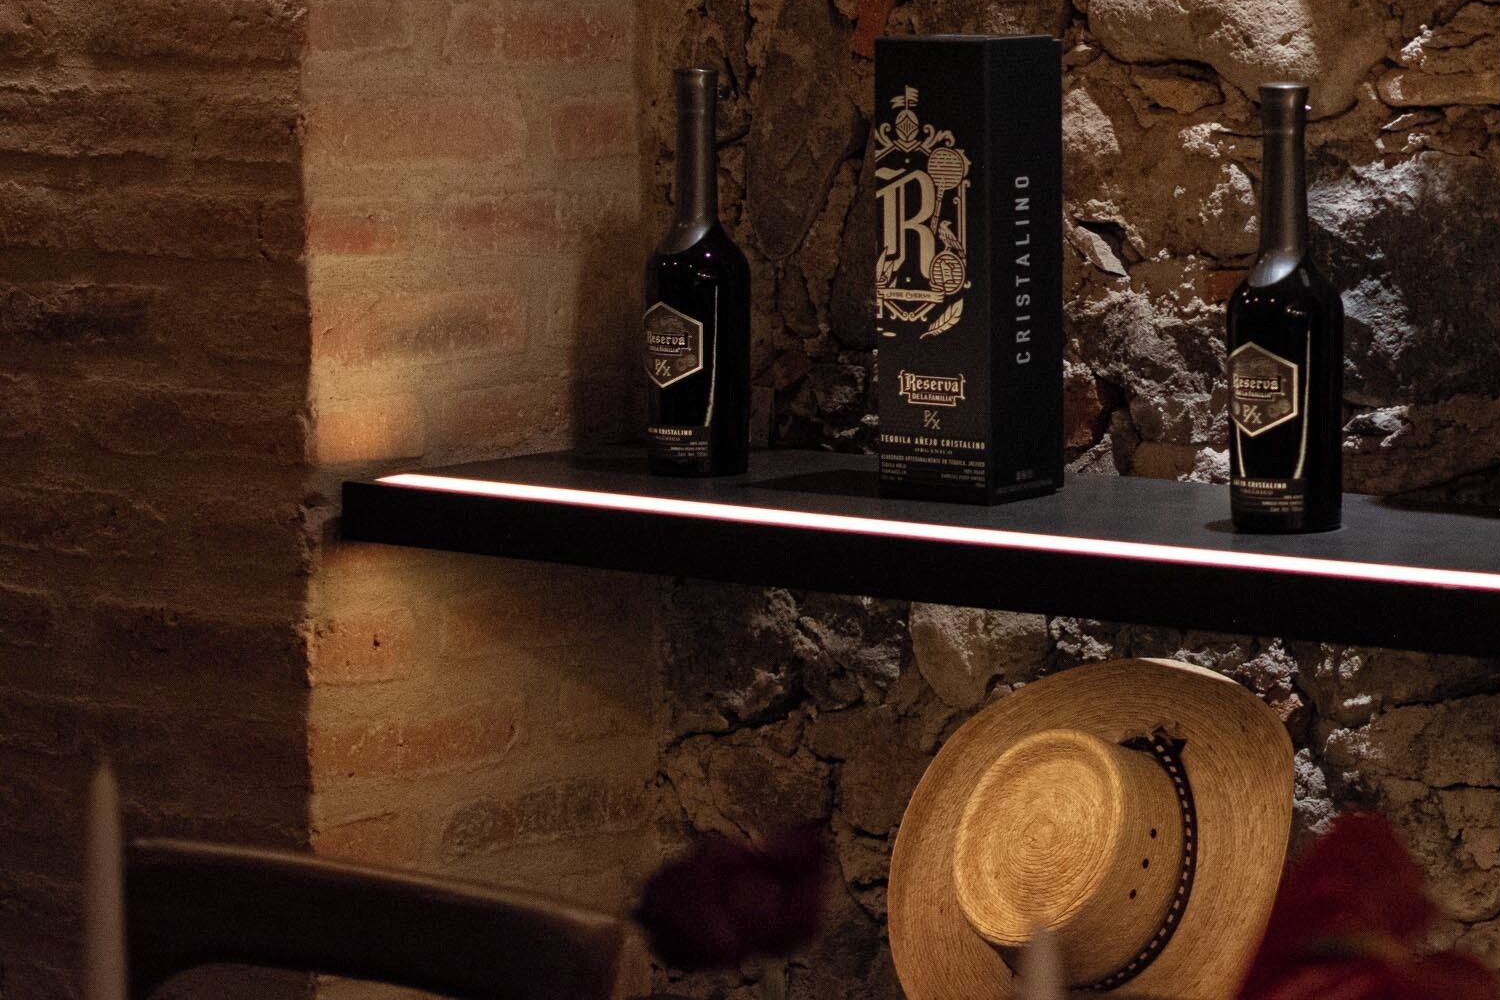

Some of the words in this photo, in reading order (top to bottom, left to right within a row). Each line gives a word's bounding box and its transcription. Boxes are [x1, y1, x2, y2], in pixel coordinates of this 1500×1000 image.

[1015, 175, 1031, 364] CRISTALINO
[903, 373, 959, 392] Reserva
[1232, 373, 1279, 390] Reserva
[881, 433, 911, 444] TEQUILA
[914, 436, 938, 447] AÑEJO
[941, 439, 985, 450] CRISTALINO
